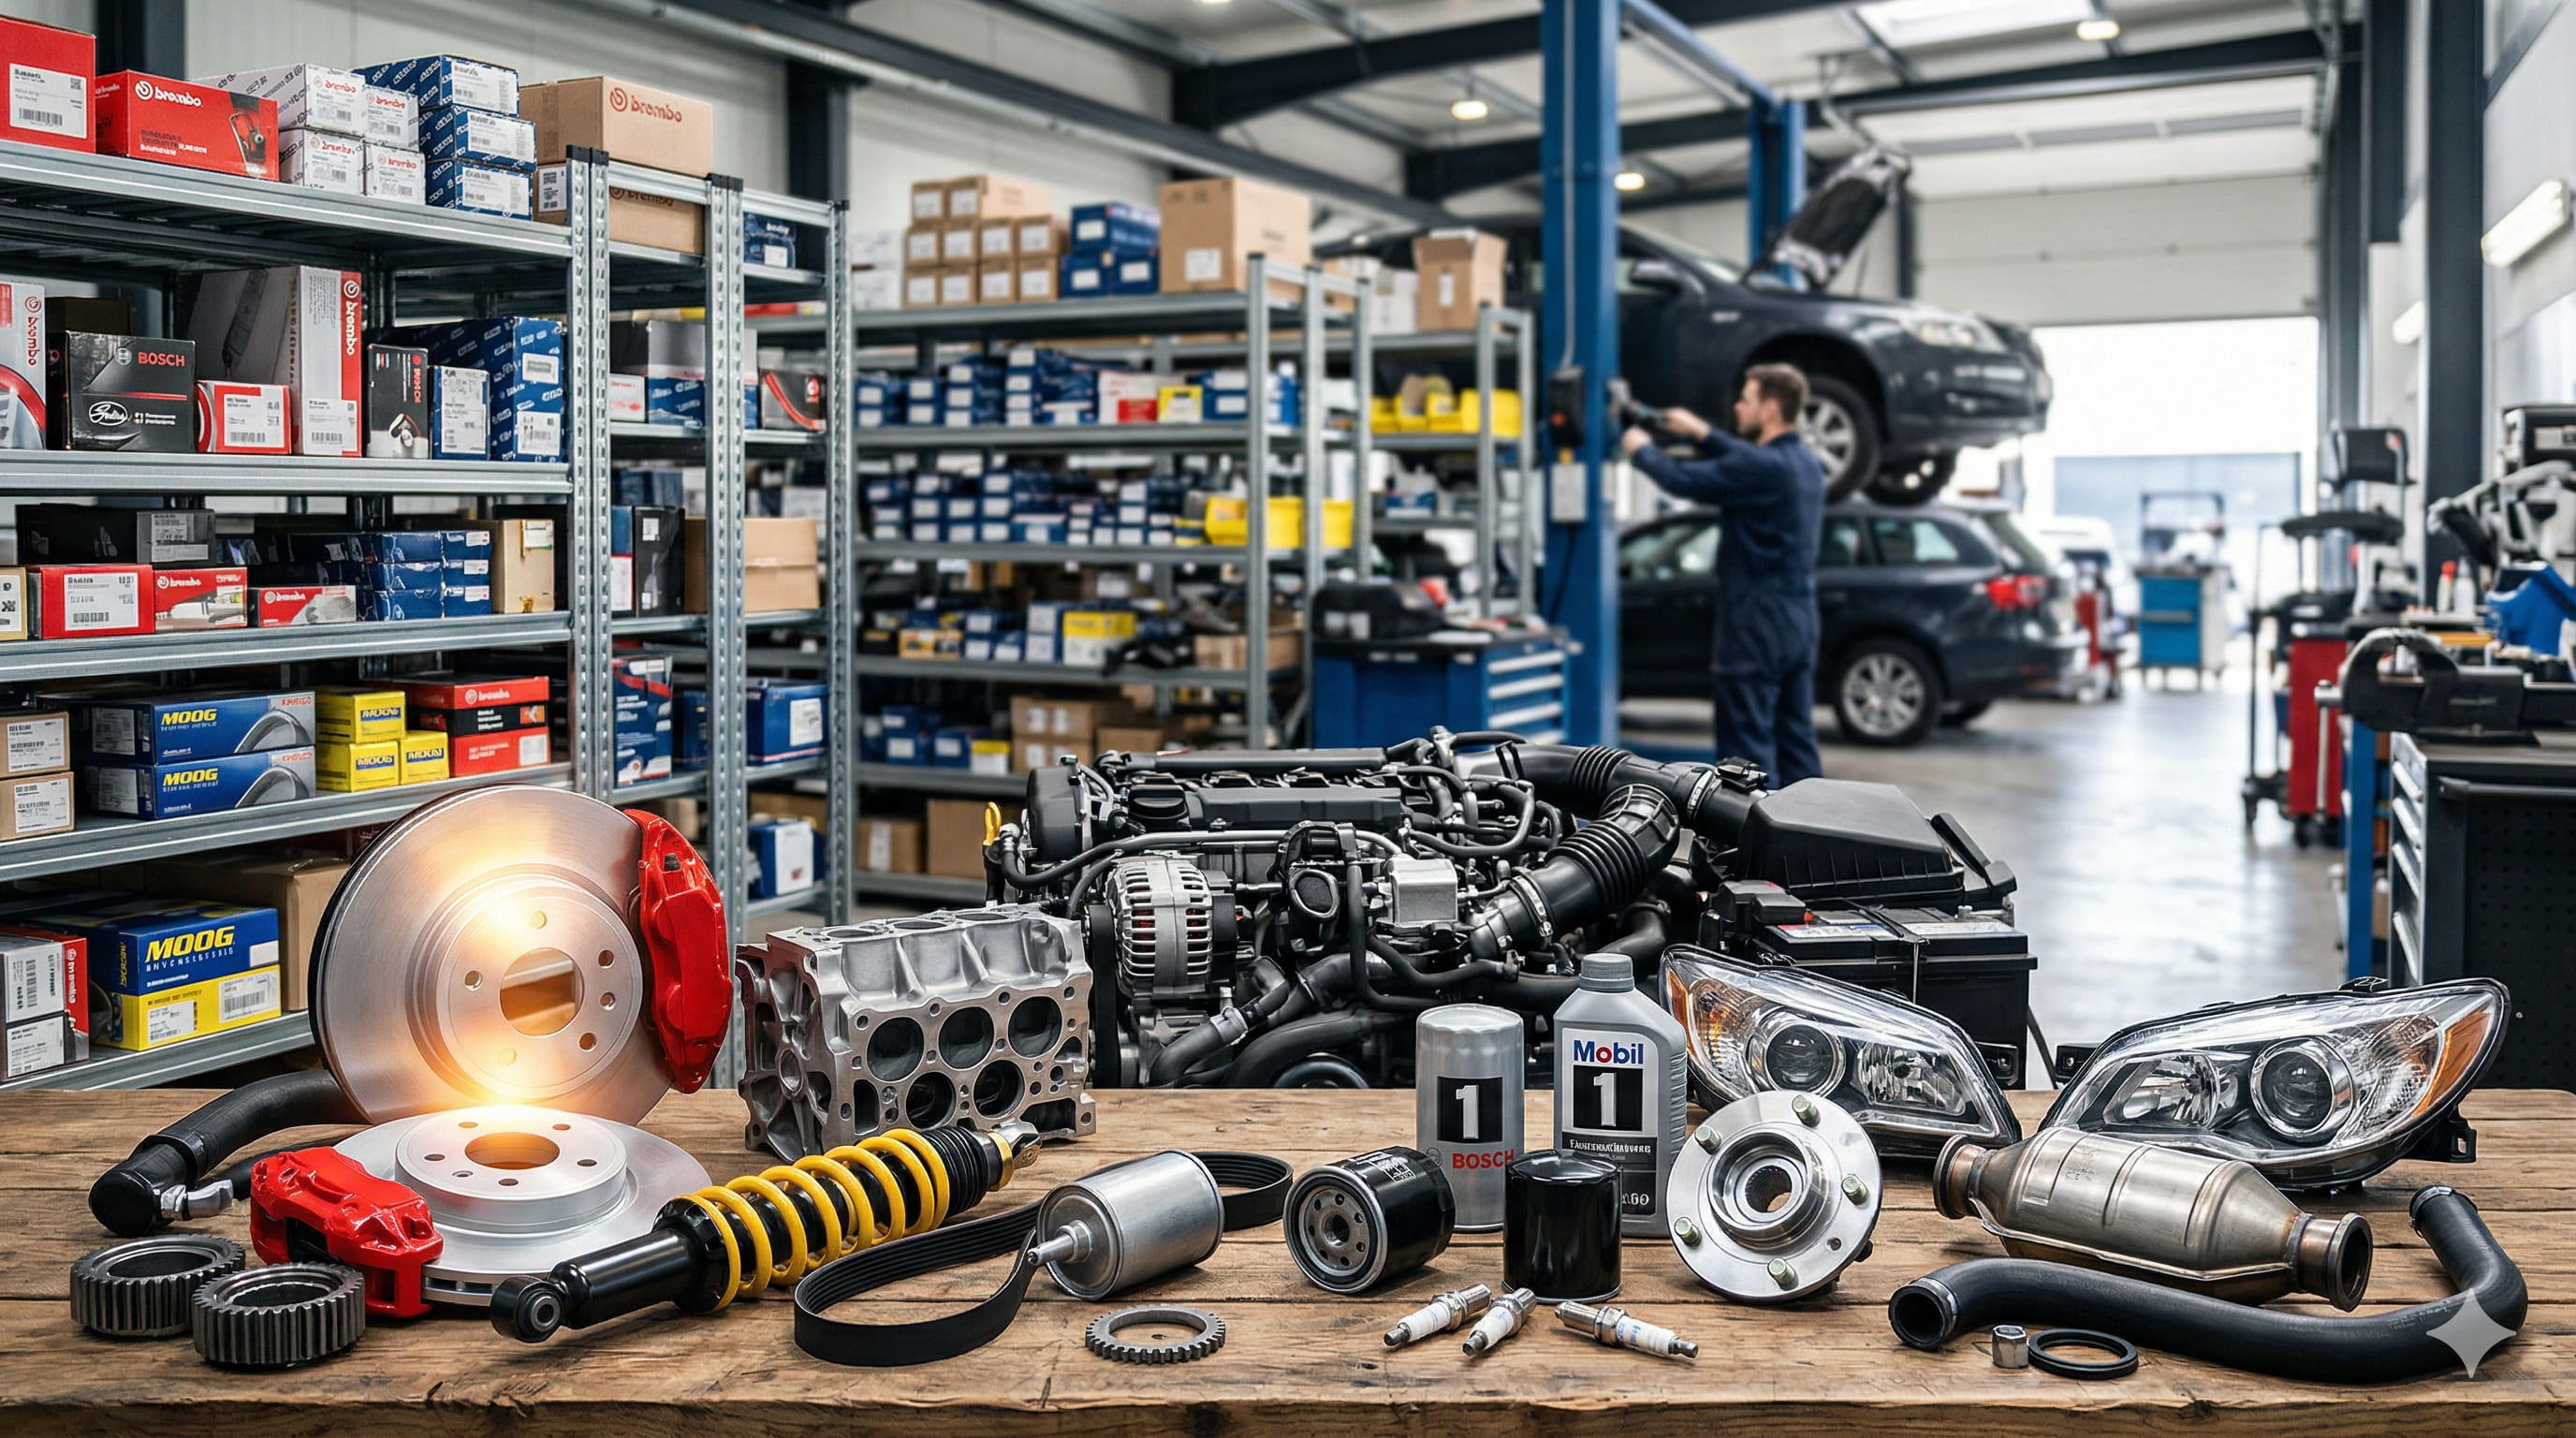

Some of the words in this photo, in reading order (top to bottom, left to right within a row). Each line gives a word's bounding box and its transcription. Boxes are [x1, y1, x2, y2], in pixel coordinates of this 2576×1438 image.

[631, 95, 682, 123] brembo
[138, 351, 185, 367] BOSCH
[161, 709, 218, 726] MOOG
[163, 768, 219, 786] MOOG
[145, 926, 236, 963] MOOG
[1573, 1039, 1644, 1065] Mobil
[1456, 1084, 1479, 1139] 1
[1592, 1072, 1617, 1127] 1
[1452, 1148, 1515, 1169] BOSCH
